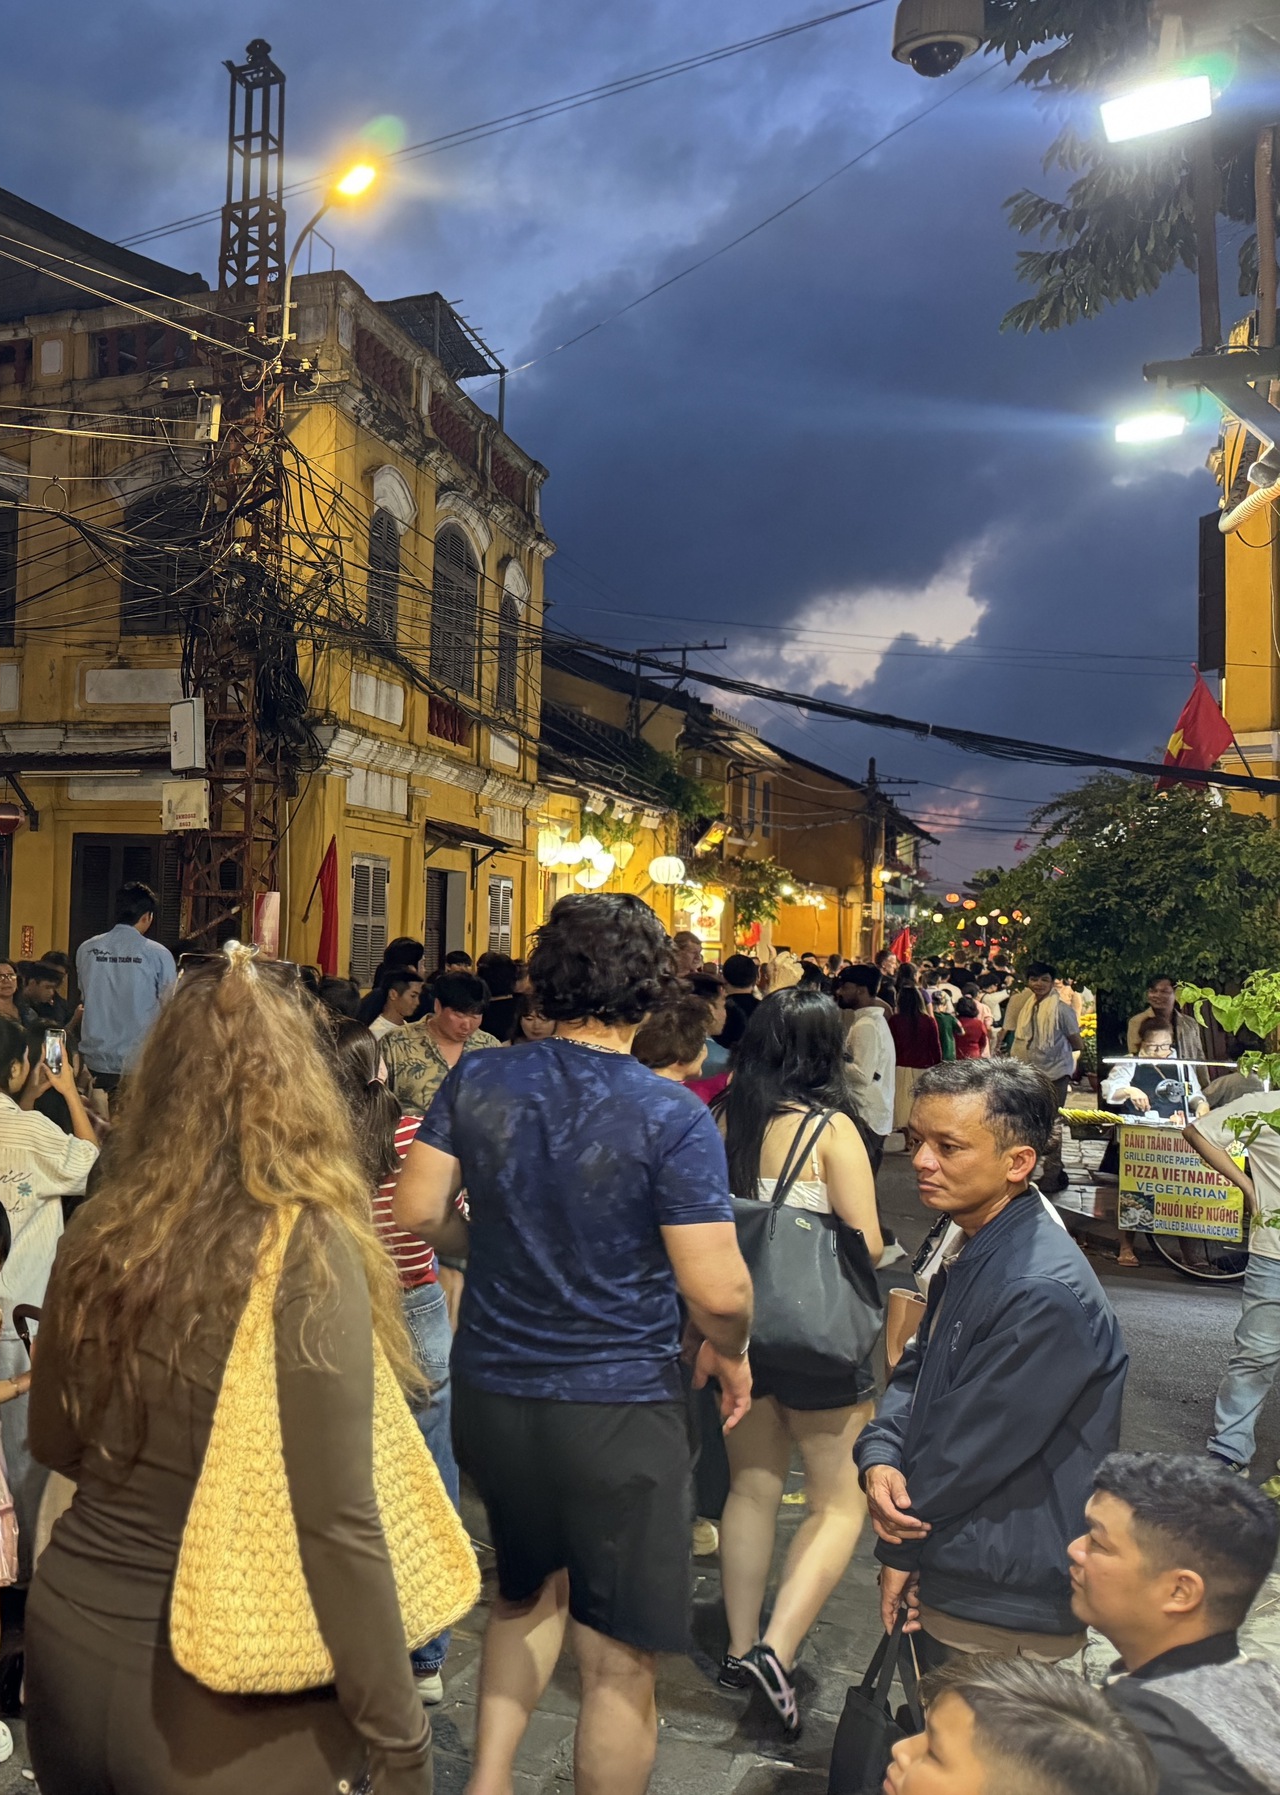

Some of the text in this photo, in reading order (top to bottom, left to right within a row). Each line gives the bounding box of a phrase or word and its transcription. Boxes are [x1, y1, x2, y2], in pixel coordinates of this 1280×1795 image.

[1123, 1151, 1200, 1167] GRILLED RICE PAPER
[1124, 1163, 1236, 1188] PIZZA VIETNAMES
[1136, 1181, 1227, 1200] VEGETARIAN
[1154, 1219, 1239, 1238] GRILLED BANANA RICE CAKE
